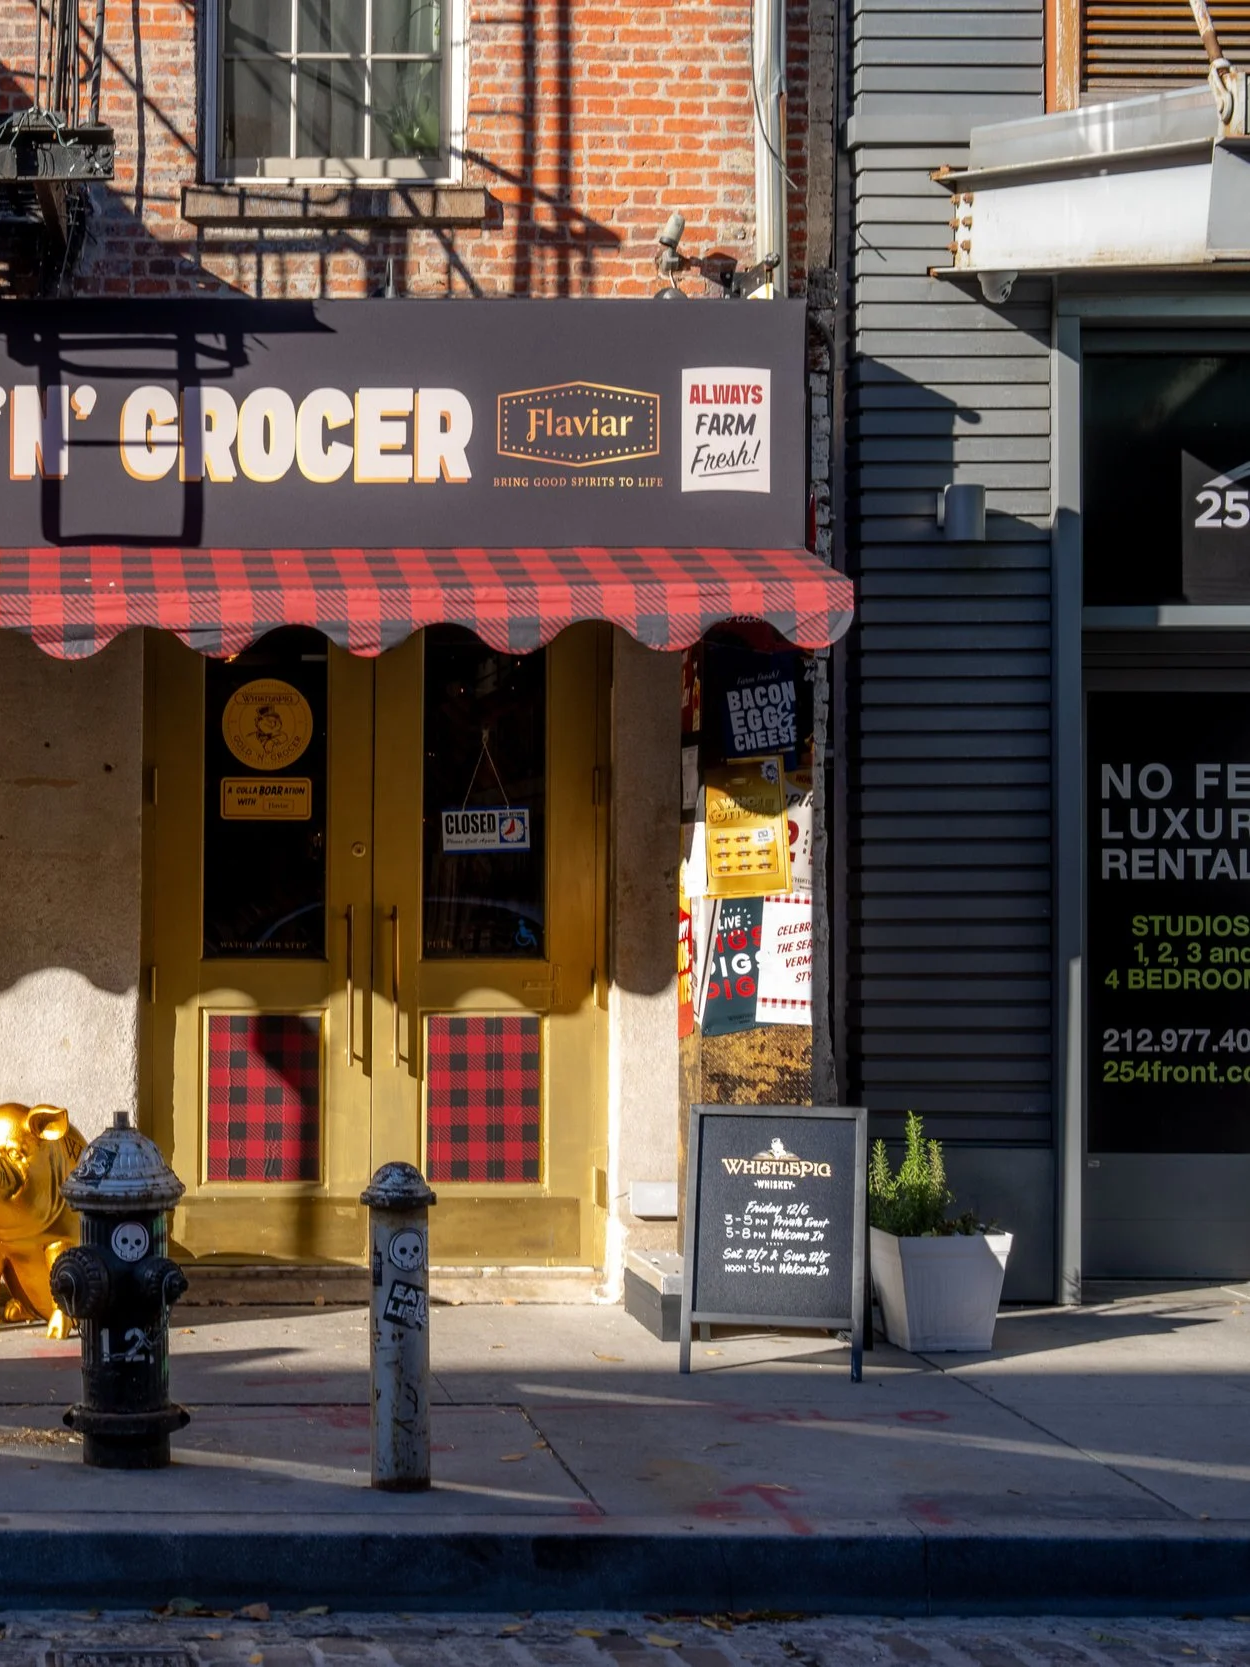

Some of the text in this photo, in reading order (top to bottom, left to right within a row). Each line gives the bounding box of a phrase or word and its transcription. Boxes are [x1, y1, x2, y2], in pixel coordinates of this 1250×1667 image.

[690, 384, 763, 405] ALWAYS
[120, 385, 473, 483] GROCER
[527, 408, 634, 443] Flaviar
[696, 413, 756, 436] FARM
[691, 439, 761, 474] Fresh!
[493, 477, 664, 488] BRING GOOD SPIRITS TO LIFE
[726, 680, 796, 712] BACON
[730, 704, 780, 735] EGG
[734, 725, 798, 752] CHEESE
[1101, 763, 1173, 800] NO
[237, 798, 257, 806] WITH
[445, 813, 496, 835] CLOSED
[718, 915, 741, 930] LIVE
[777, 921, 812, 937] CELEBR
[1132, 915, 1249, 937] STUDIOS
[777, 942, 794, 954] THE
[1134, 942, 1150, 966] 1,
[1157, 942, 1179, 966] 2,
[1187, 942, 1202, 963] 3
[1104, 968, 1120, 990] 4
[756, 1180, 793, 1190] WHISKEY
[745, 1200, 810, 1217] Friday 12/6
[755, 1218, 769, 1226] PM
[773, 1214, 803, 1228] Private
[804, 1216, 830, 1228] Event
[753, 1231, 766, 1239] PM
[771, 1227, 810, 1241] Welcome
[810, 1230, 824, 1242] In
[722, 1247, 830, 1265] Sat 12/7 & Sun 12/8
[779, 1262, 817, 1275] Welcome
[816, 1265, 829, 1276] In
